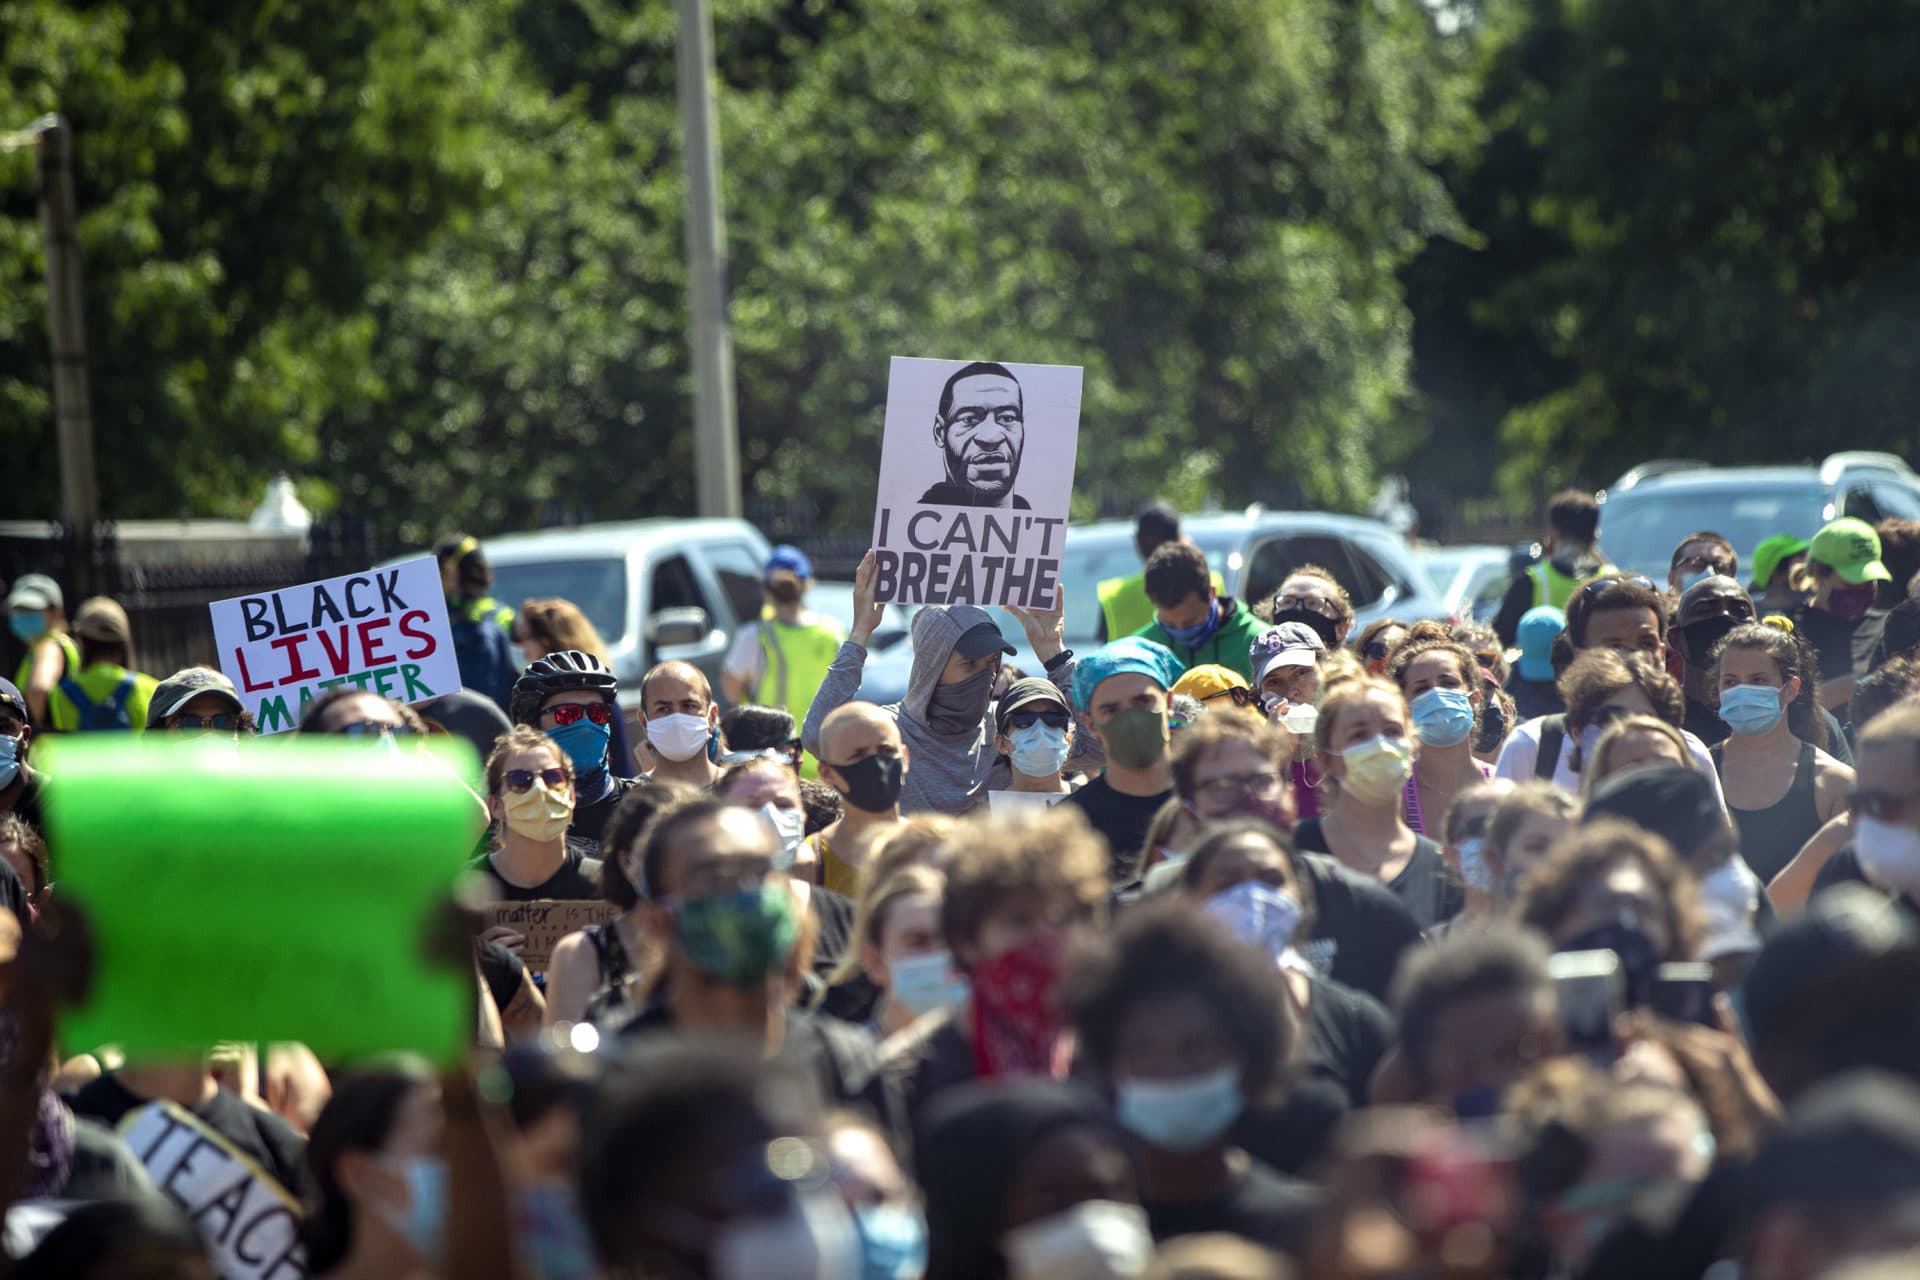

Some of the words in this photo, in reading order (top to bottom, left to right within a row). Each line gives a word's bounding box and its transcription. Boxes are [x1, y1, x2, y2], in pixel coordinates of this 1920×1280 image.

[878, 508, 891, 547] I
[907, 510, 1064, 555] CAN'T
[240, 569, 408, 642] BLACK
[874, 550, 1059, 609] BREATHE
[235, 610, 436, 692] LIVES
